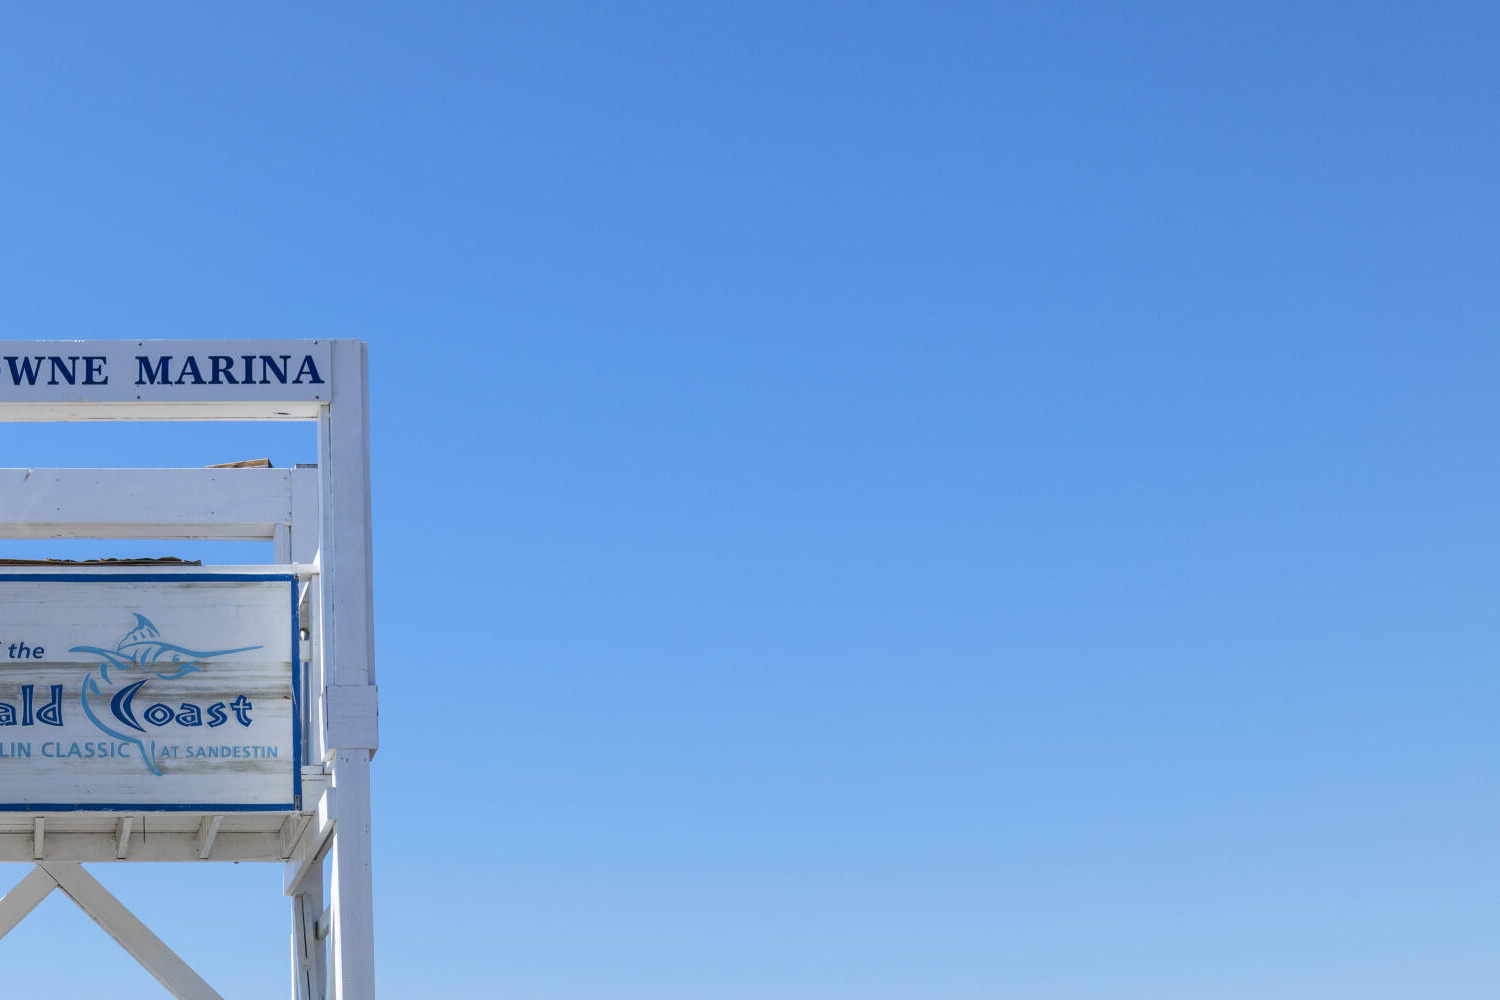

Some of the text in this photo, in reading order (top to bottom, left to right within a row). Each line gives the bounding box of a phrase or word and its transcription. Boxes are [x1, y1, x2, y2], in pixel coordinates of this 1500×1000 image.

[135, 354, 325, 384] MARINA
[8, 642, 45, 659] the
[111, 679, 253, 732] Coast
[41, 741, 130, 758] CLASSIC
[160, 746, 180, 758] AT
[186, 745, 278, 758] SANDESTIN
